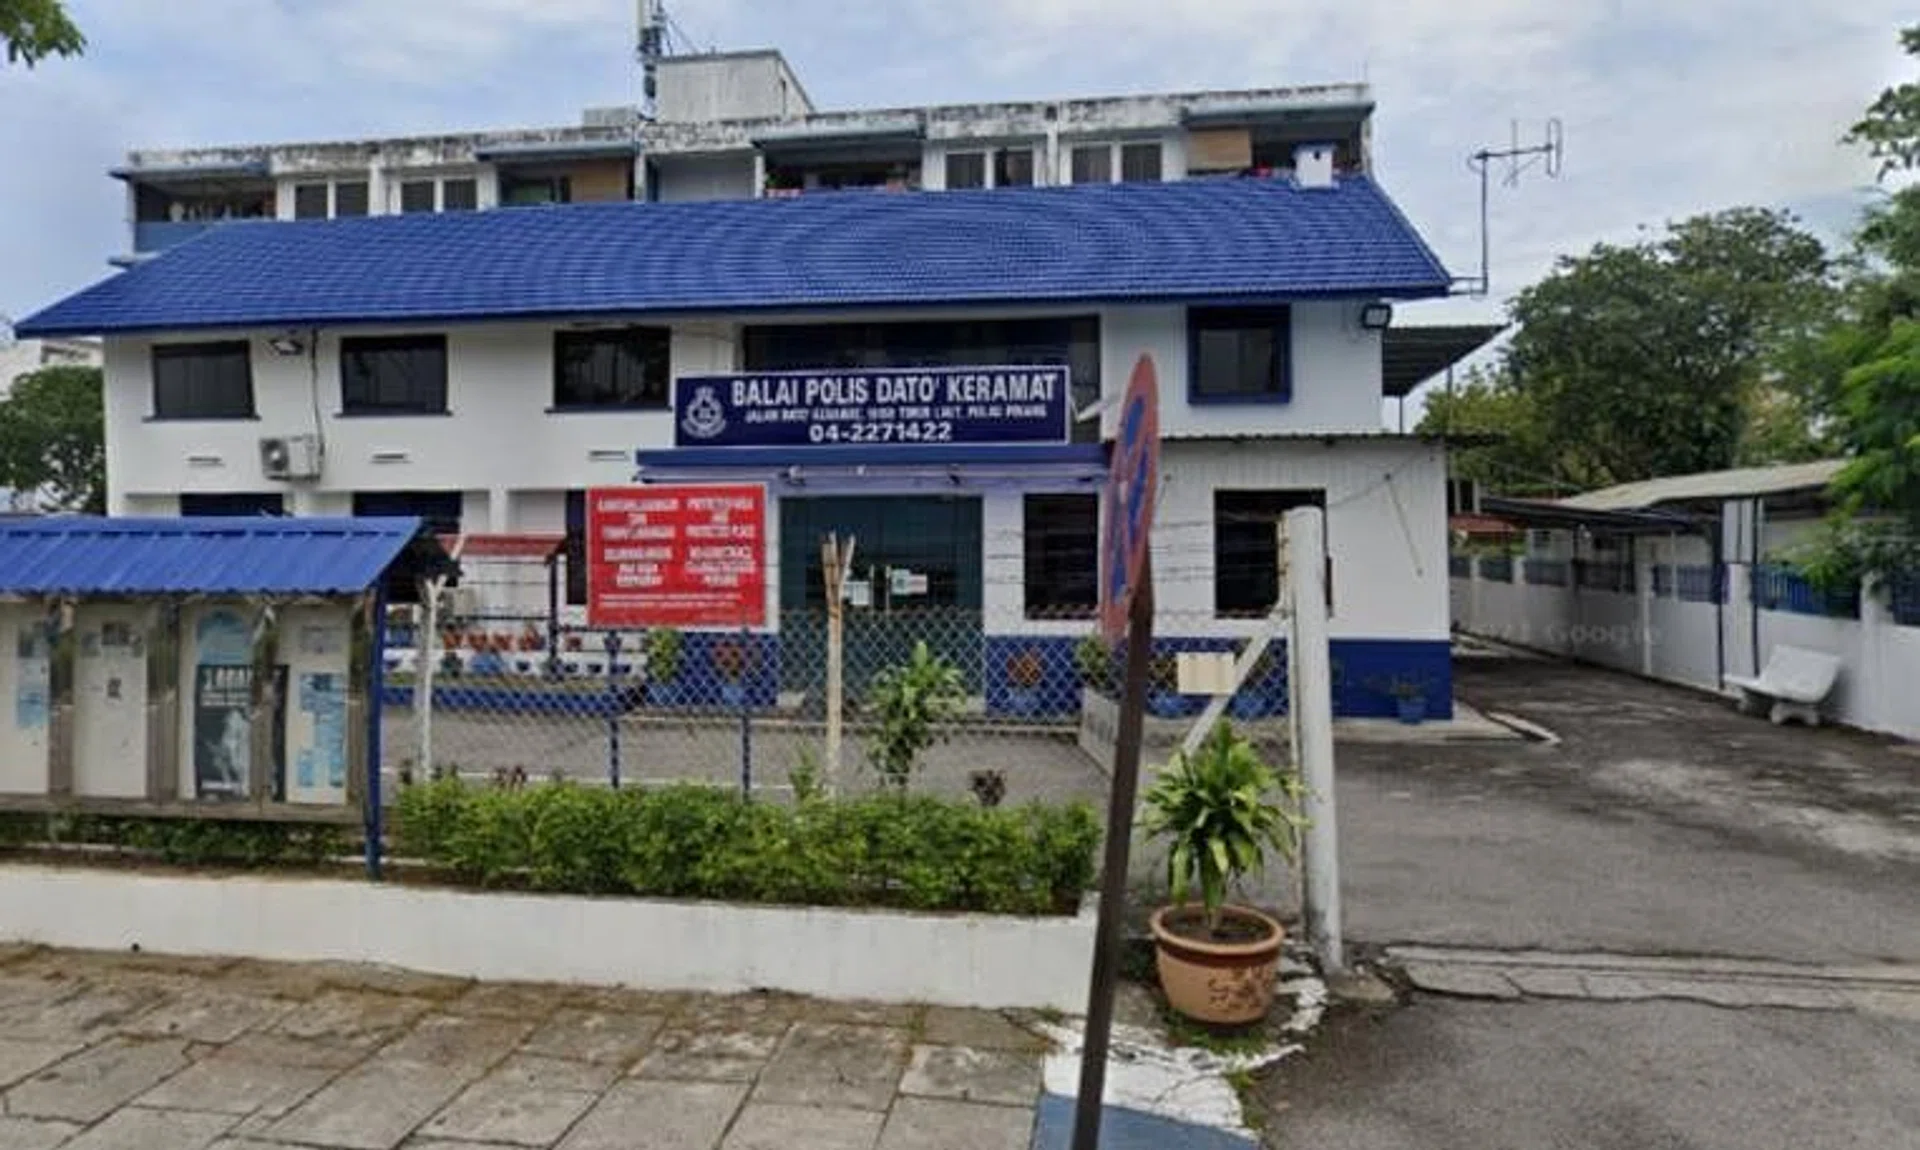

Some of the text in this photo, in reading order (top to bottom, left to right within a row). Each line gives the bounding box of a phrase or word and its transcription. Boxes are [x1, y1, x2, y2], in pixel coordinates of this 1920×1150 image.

[731, 372, 1058, 407] BALAI POLIS DATO' KERAMAT
[809, 421, 951, 442] 04-2271422
